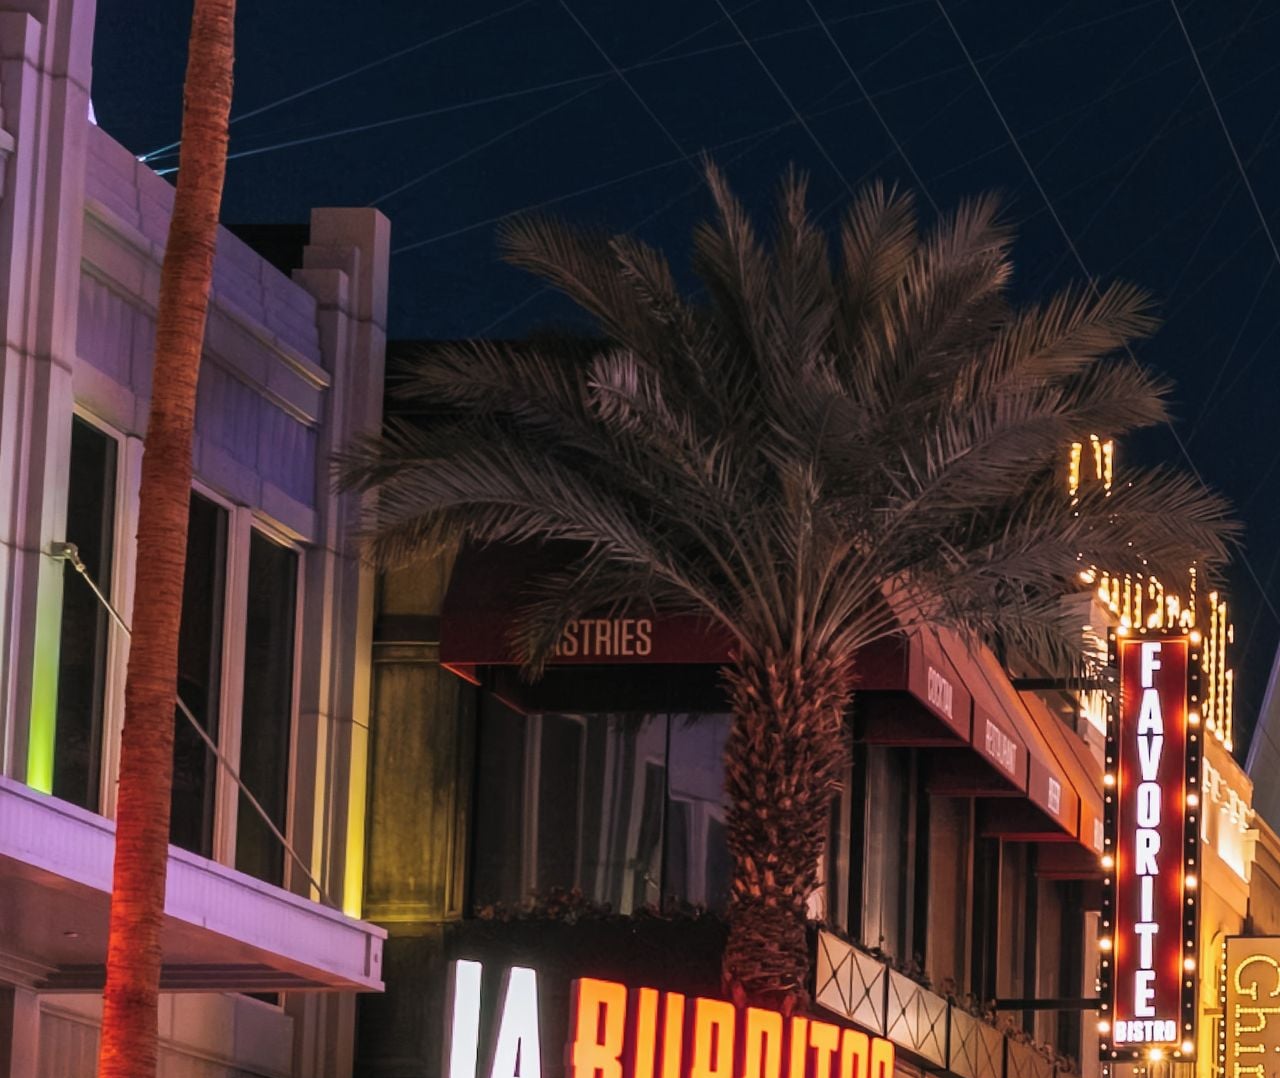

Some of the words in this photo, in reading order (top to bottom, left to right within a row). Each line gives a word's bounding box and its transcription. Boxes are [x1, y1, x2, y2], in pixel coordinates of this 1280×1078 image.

[553, 618, 652, 656] STRIES
[1134, 641, 1163, 1018] FAVORITE
[1115, 1019, 1176, 1042] BISTRO
